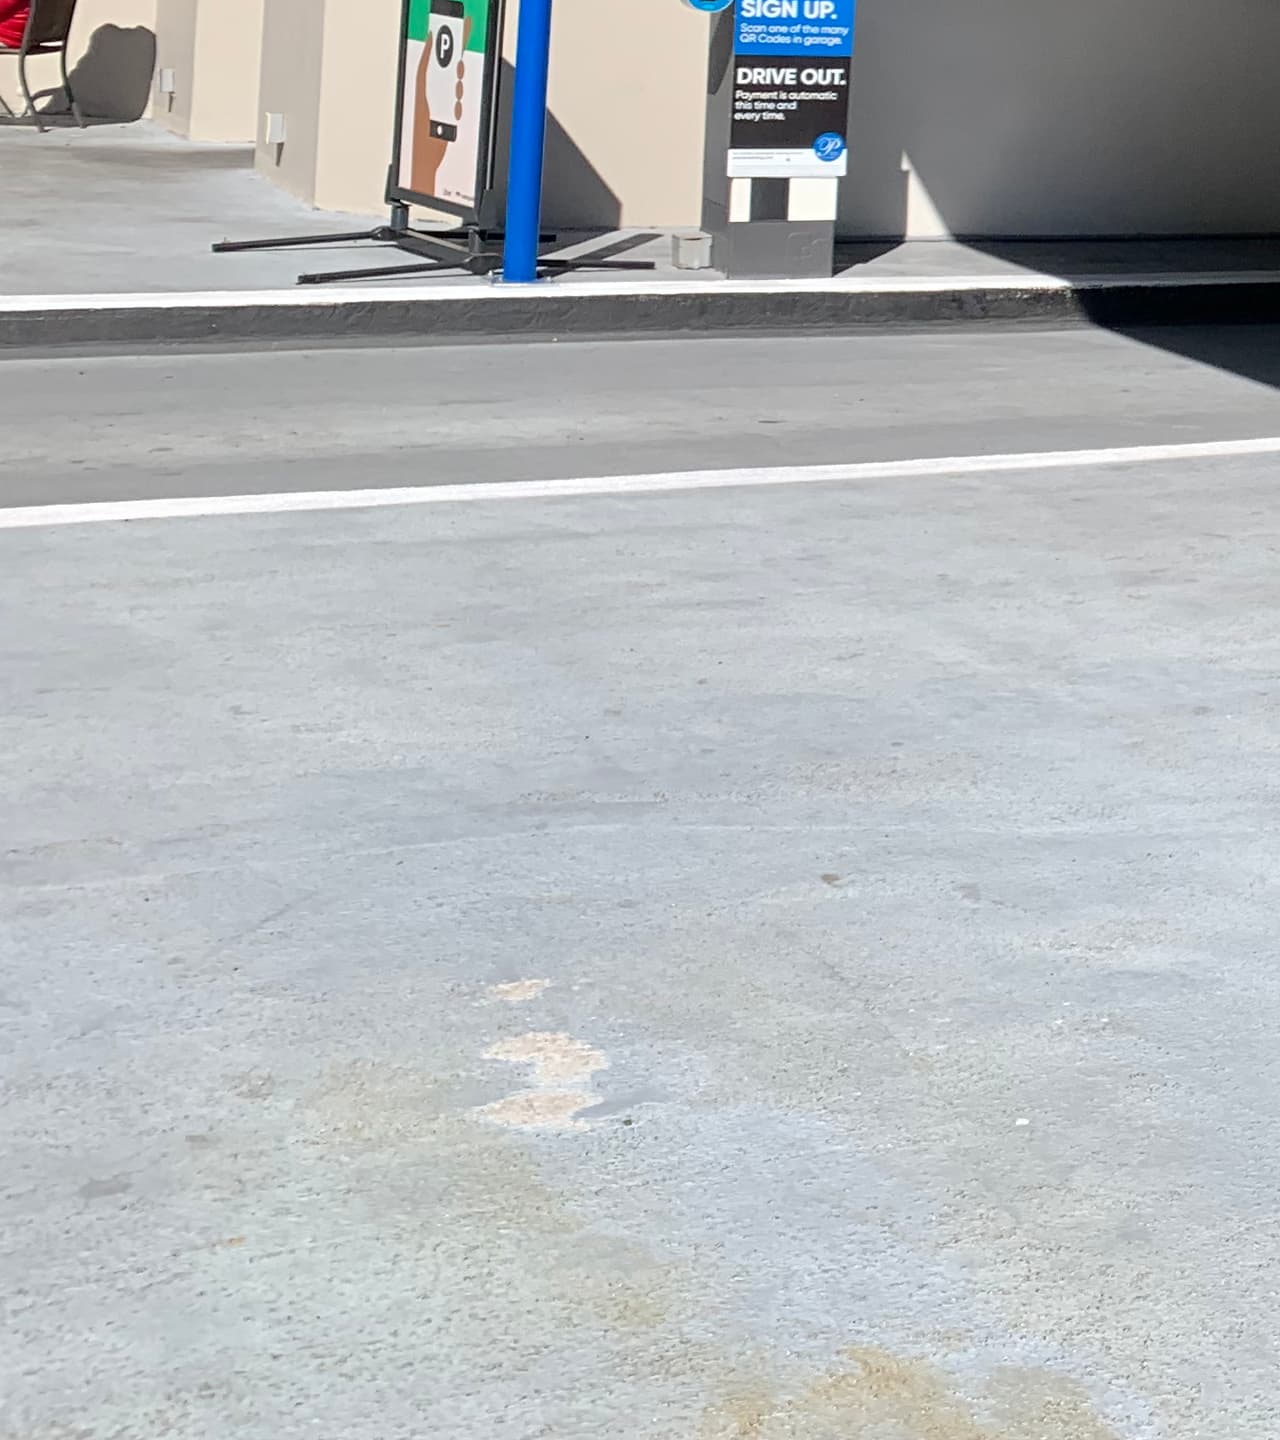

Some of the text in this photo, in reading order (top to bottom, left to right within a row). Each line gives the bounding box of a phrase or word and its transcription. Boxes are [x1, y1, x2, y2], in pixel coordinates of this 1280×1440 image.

[803, 0, 838, 20] UP.
[739, 23, 850, 36] Scan one of the many
[739, 33, 757, 43] QR
[758, 34, 791, 44] Codes
[792, 35, 803, 44] in
[441, 33, 450, 59] P
[736, 67, 847, 85] DRIVE OUT.
[735, 90, 838, 101] Payment is automatic
[734, 100, 798, 110] this time and
[733, 112, 760, 122] every
